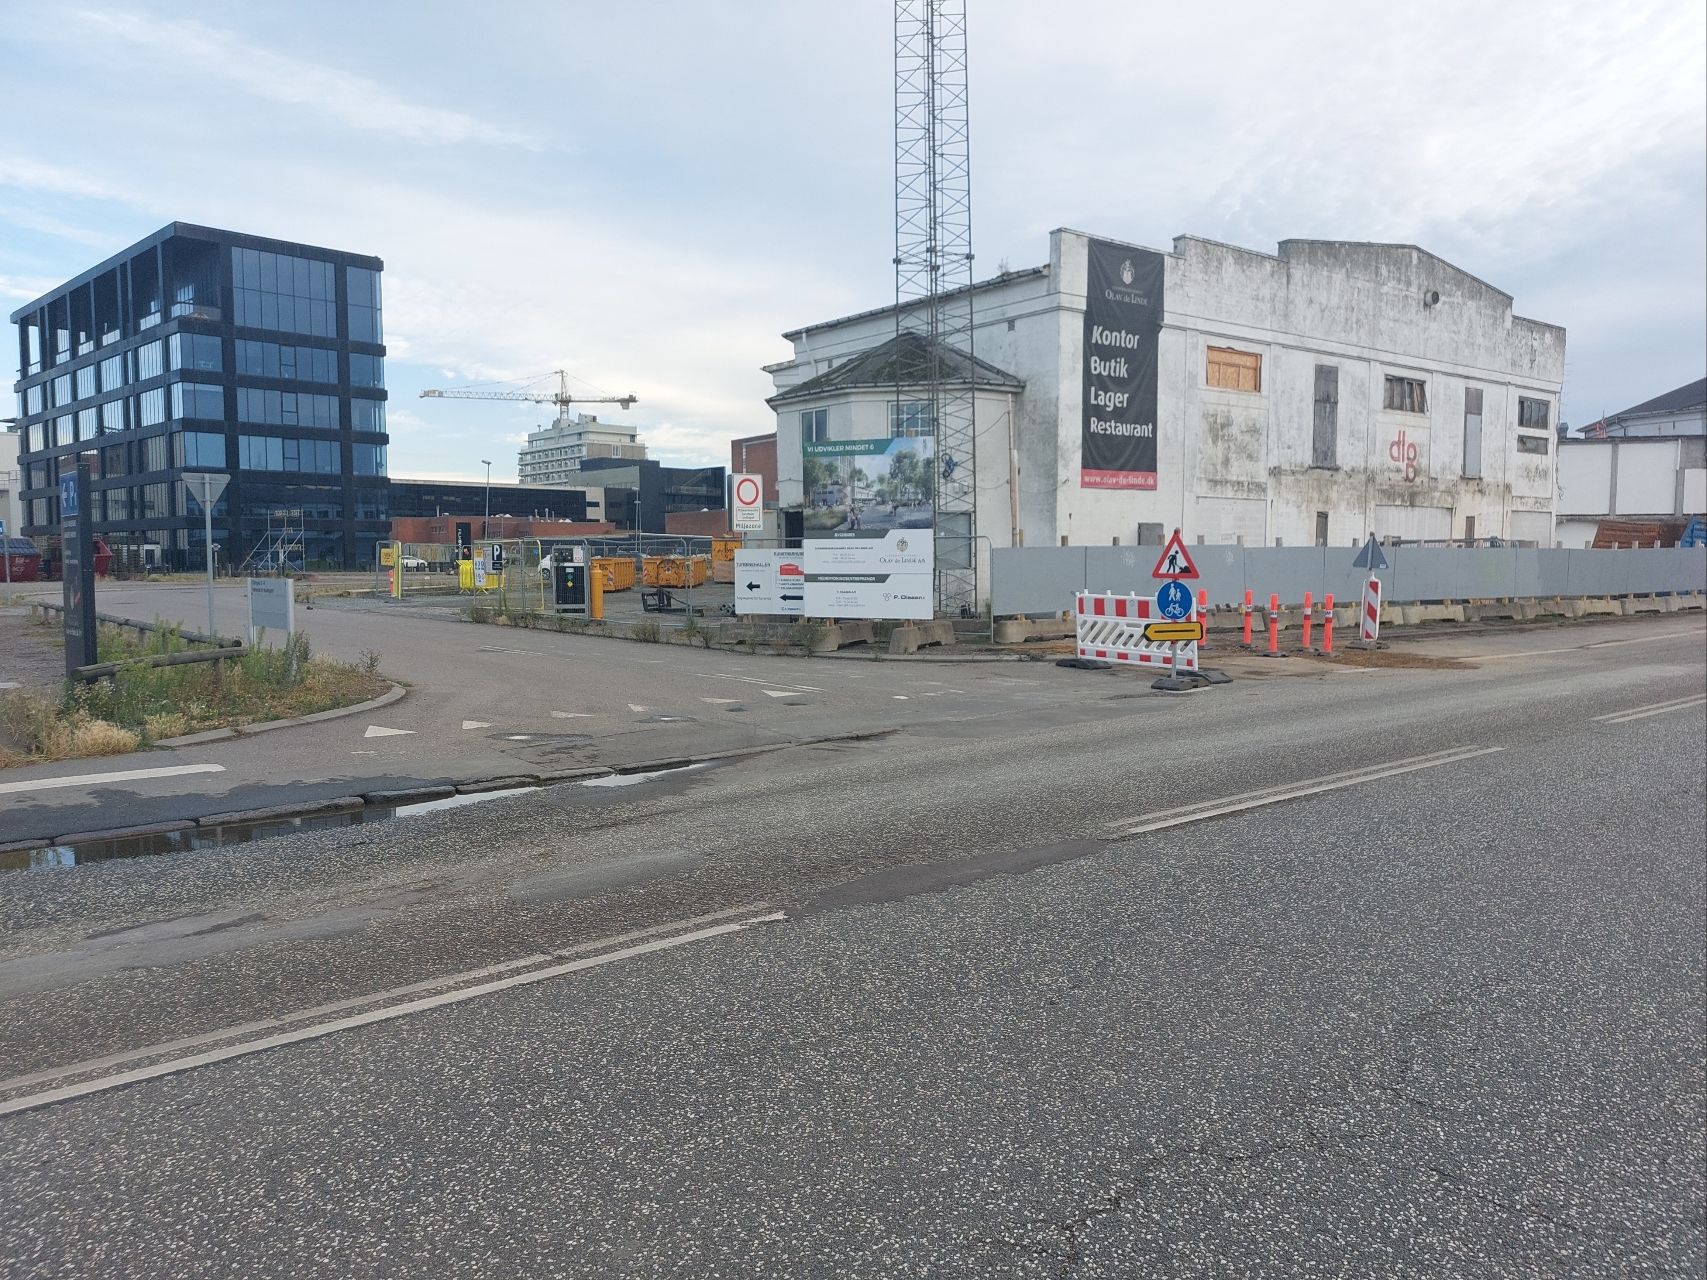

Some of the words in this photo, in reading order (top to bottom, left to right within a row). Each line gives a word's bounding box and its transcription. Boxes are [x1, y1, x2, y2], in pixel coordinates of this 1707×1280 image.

[1091, 324, 1140, 350] Kontor
[1090, 355, 1128, 379] Butik
[1090, 386, 1129, 412] Lager
[1090, 416, 1153, 438] Restaurant
[814, 445, 844, 453] UDVIKLER
[1389, 430, 1417, 483] dlg
[1084, 475, 1155, 486] www.olav-de-linde.dk
[493, 544, 501, 561] P
